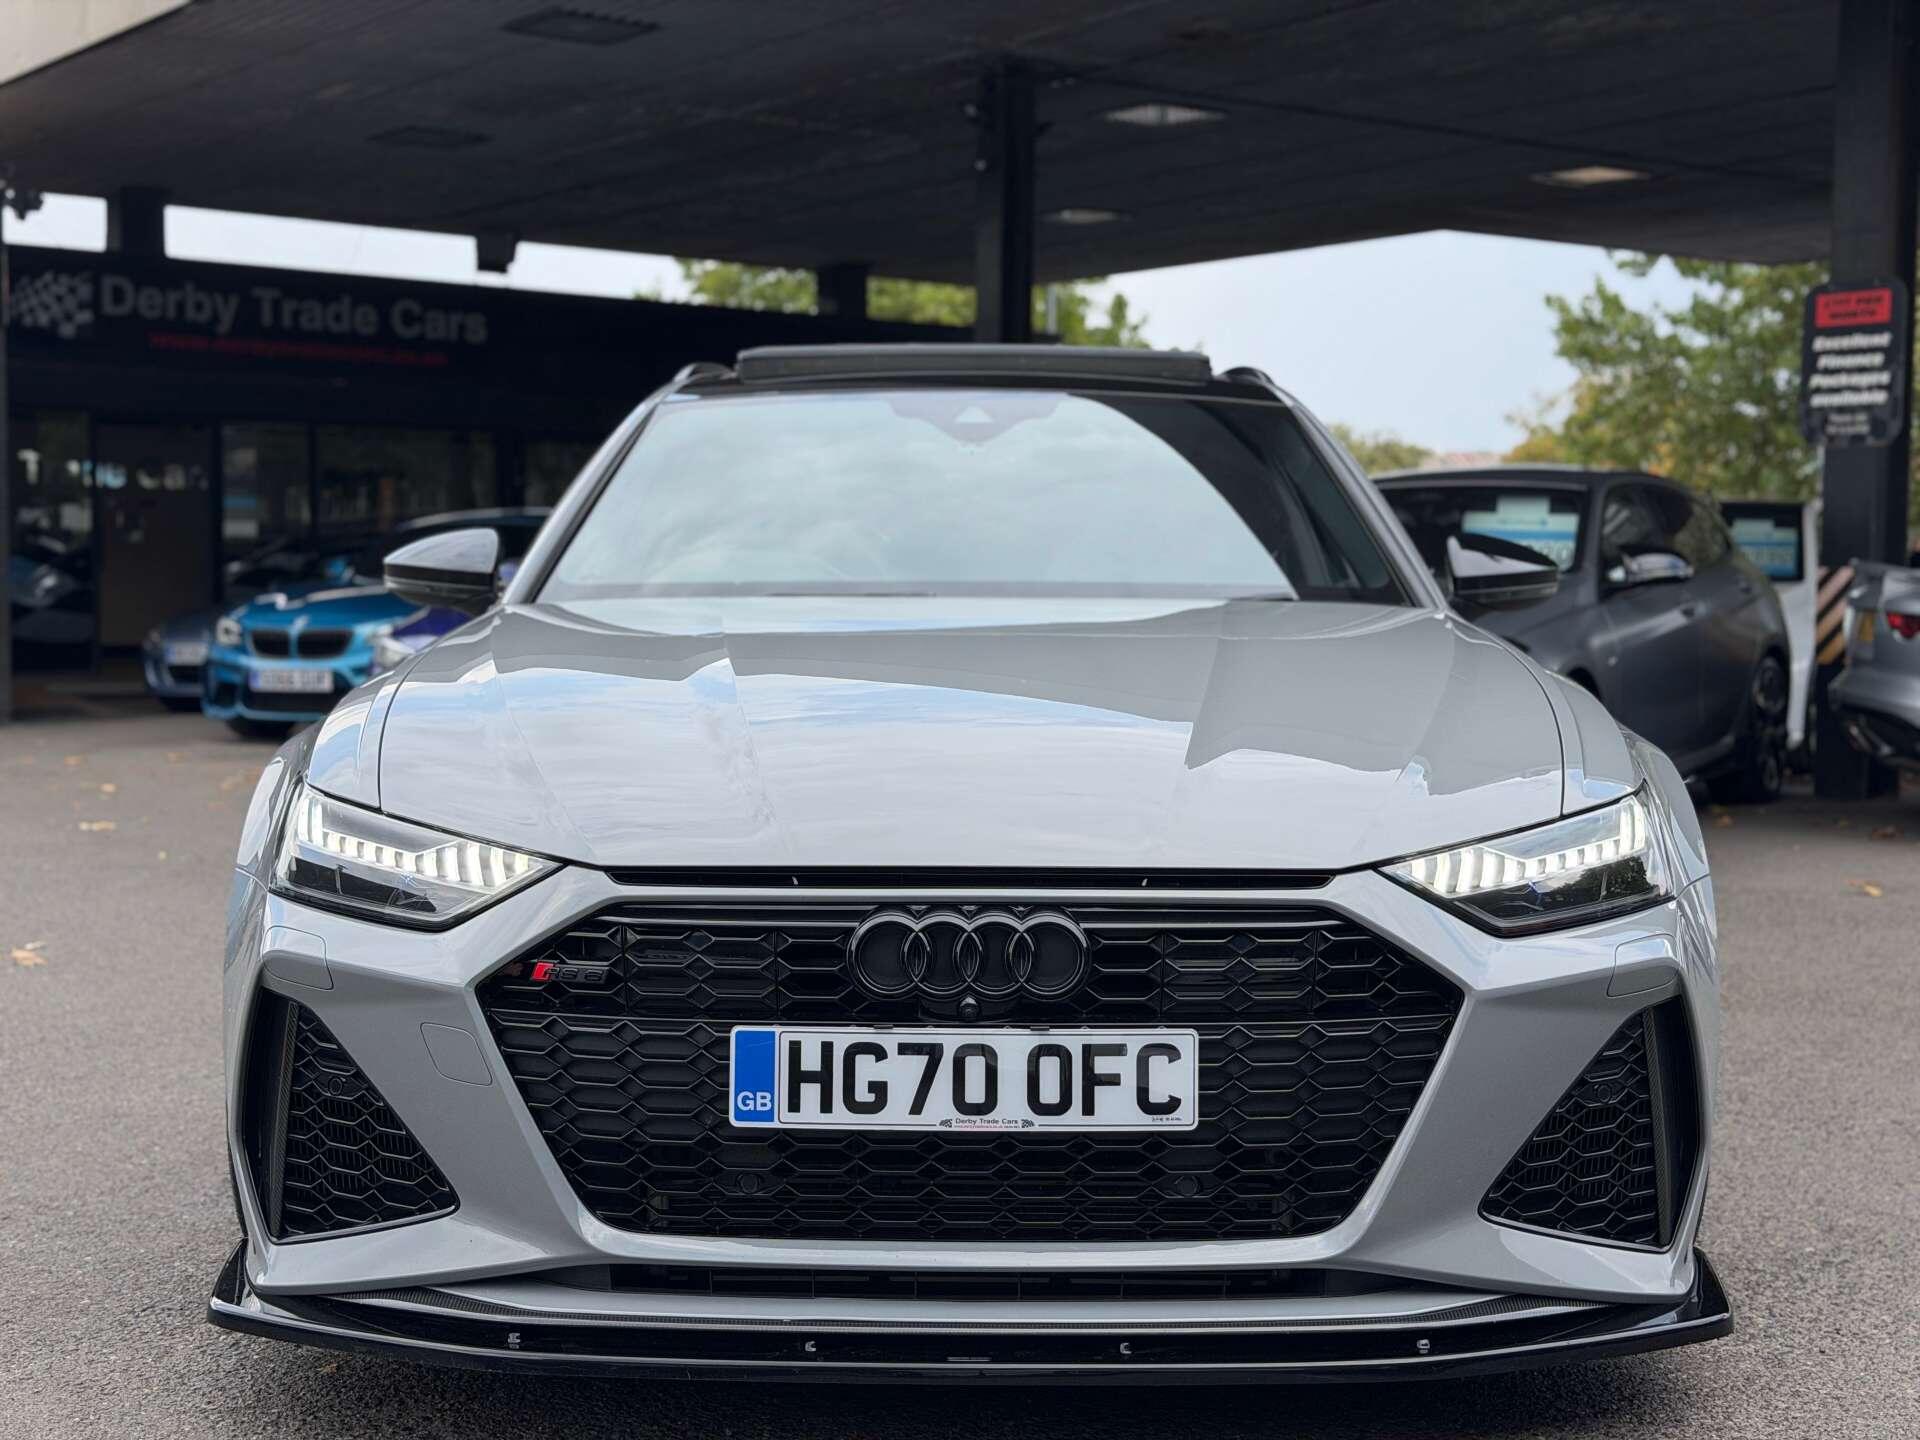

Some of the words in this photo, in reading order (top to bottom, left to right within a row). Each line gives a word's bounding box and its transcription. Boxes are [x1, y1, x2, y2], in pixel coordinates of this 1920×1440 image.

[101, 275, 239, 333] Derby
[251, 286, 378, 335] Trade
[390, 299, 488, 343] Cars
[786, 1040, 999, 1116] HG70
[1026, 1043, 1182, 1116] OFC
[736, 1091, 773, 1112] GB
[955, 1118, 977, 1126] Derby
